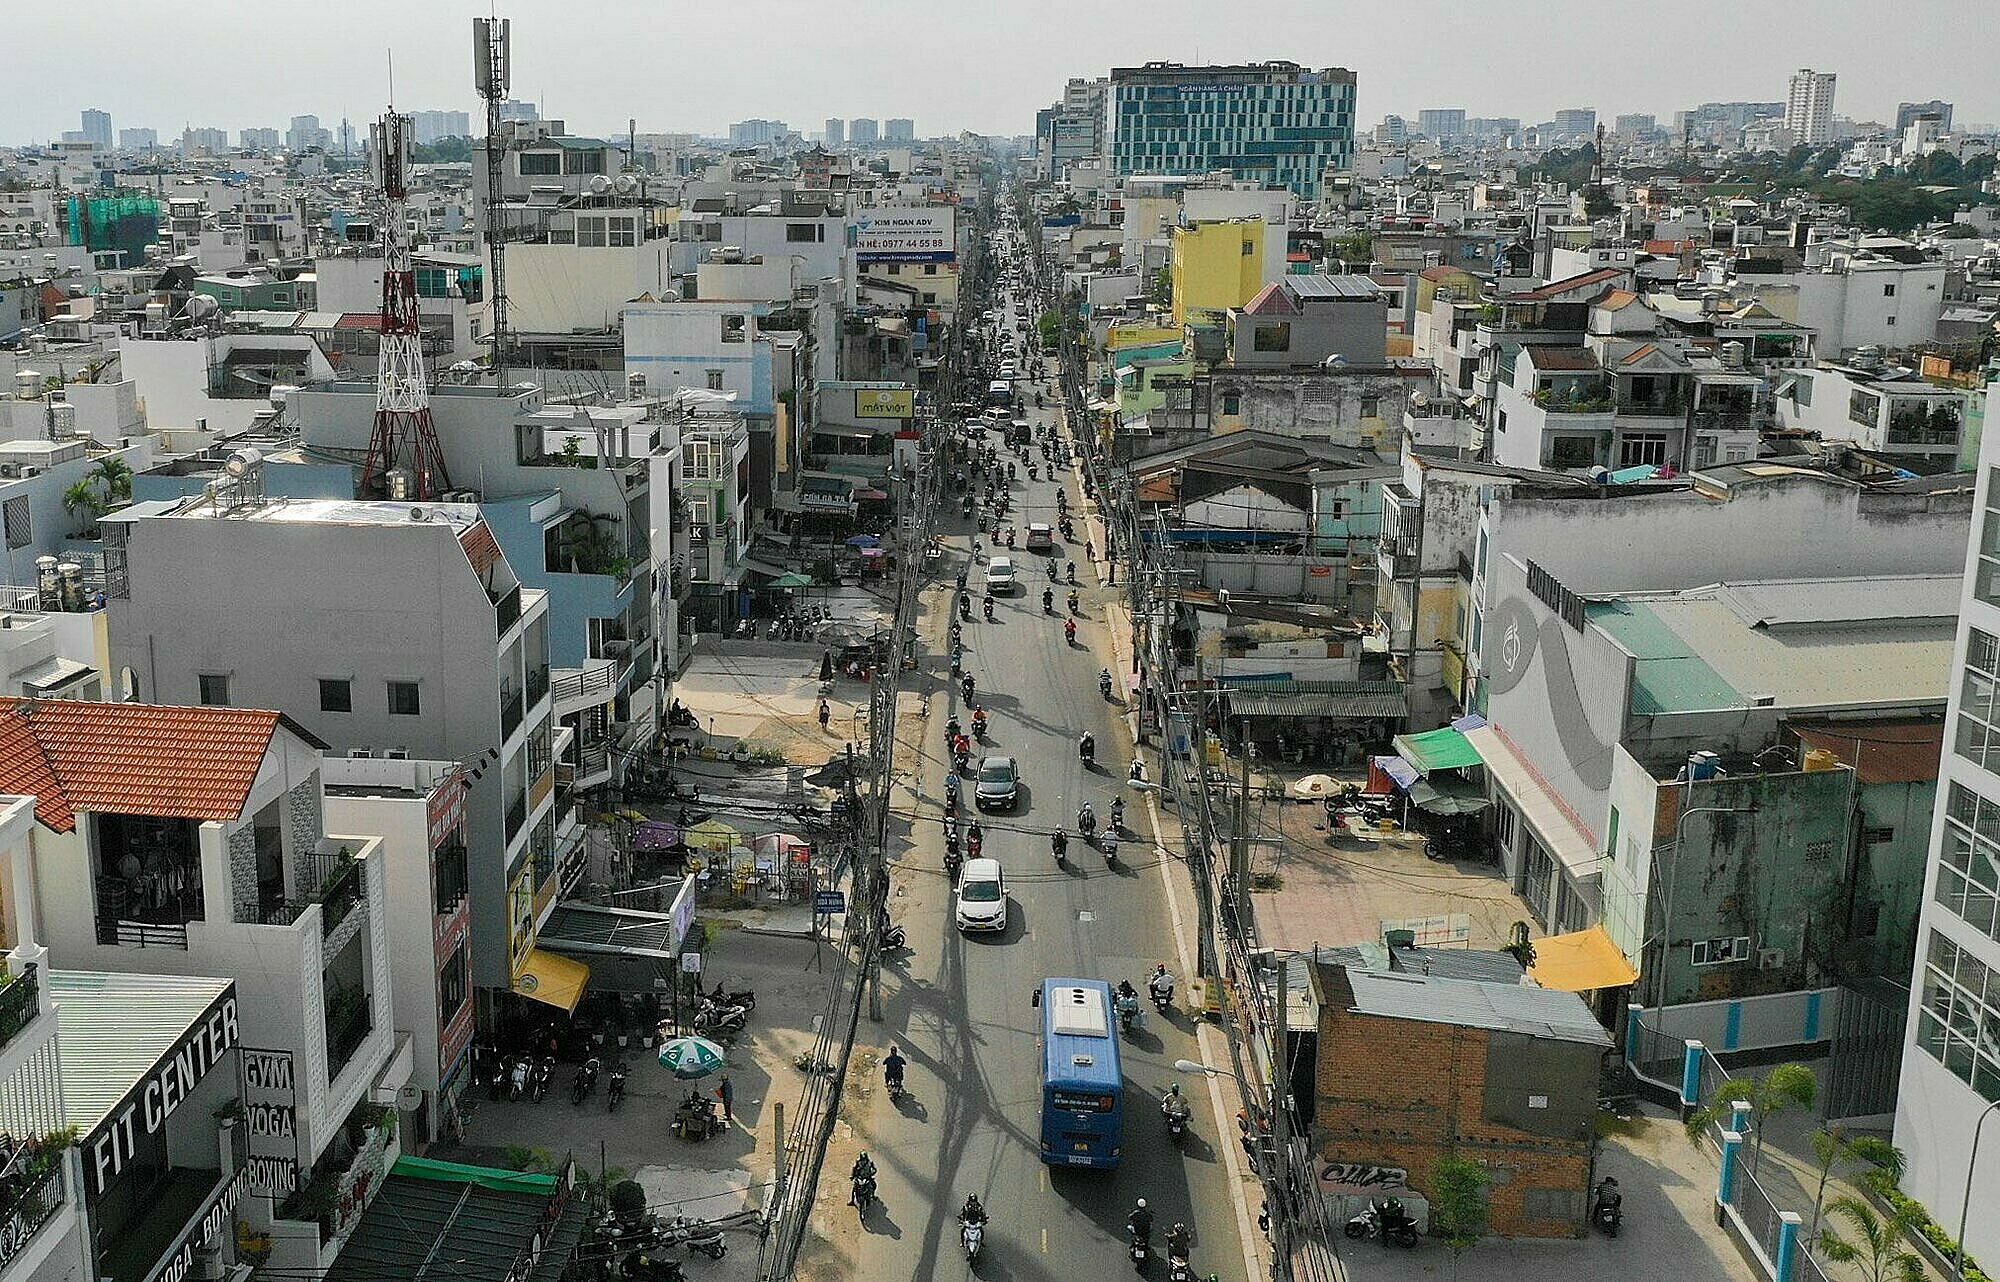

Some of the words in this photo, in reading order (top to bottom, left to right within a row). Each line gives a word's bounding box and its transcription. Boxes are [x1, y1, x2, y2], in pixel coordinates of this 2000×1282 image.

[916, 218, 933, 226] ADV
[882, 239, 904, 248] 0977
[906, 239, 917, 248] 44
[245, 1055, 291, 1090] GYM
[94, 1102, 136, 1195] FIT
[144, 998, 239, 1135] CENTER
[246, 1105, 294, 1139] YOGA
[248, 1157, 296, 1192] BOXING
